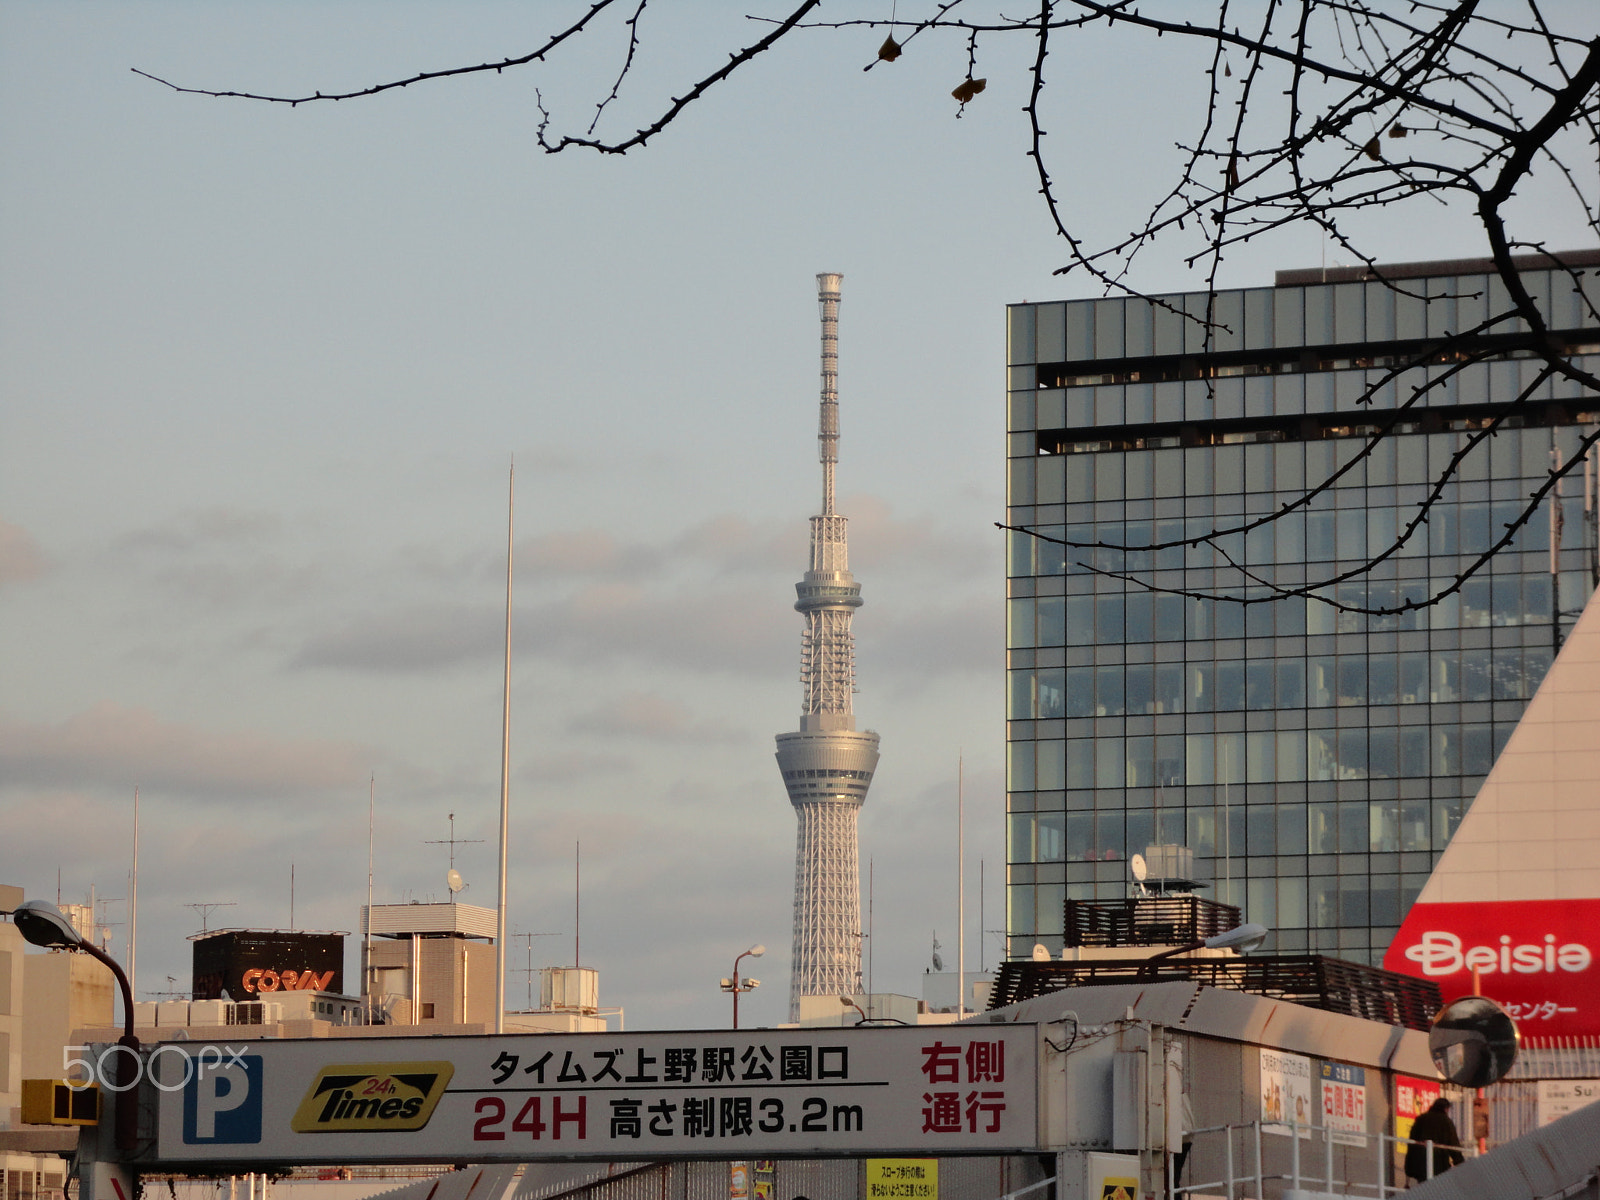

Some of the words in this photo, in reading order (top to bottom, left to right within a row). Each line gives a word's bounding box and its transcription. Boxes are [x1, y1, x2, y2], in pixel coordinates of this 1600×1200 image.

[1405, 931, 1591, 976] Beisia
[1499, 1001, 1577, 1020] センター
[490, 1045, 849, 1085] タイムズ上野駅公園口
[921, 1040, 1006, 1084] 右側
[196, 1062, 250, 1138] P
[317, 1089, 425, 1123] Times
[362, 1078, 397, 1096] 24h
[1323, 1083, 1364, 1121] 右側通行
[474, 1096, 588, 1142] 24H
[609, 1097, 864, 1139] 高さ制限3.2m
[921, 1090, 1007, 1135] 通行
